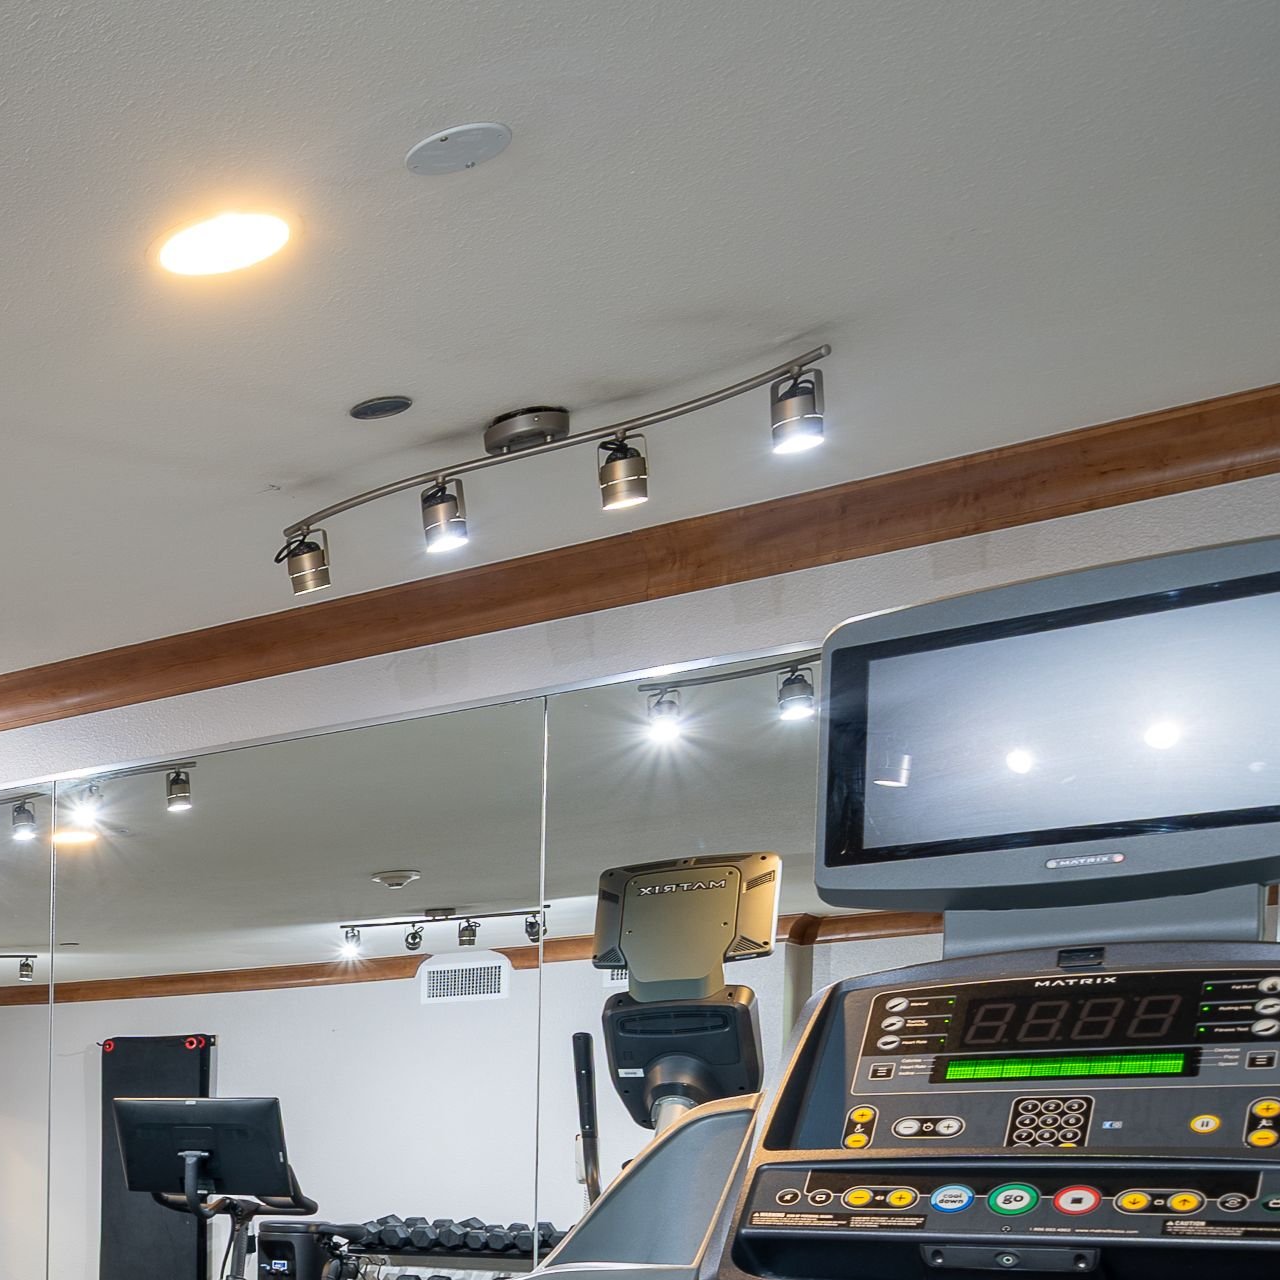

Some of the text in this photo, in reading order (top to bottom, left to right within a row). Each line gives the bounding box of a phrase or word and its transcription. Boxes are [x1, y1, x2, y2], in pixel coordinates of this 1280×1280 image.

[1059, 855, 1110, 866] MATRIX
[1034, 976, 1118, 988] MATRIX
[1002, 1194, 1024, 1205] go
